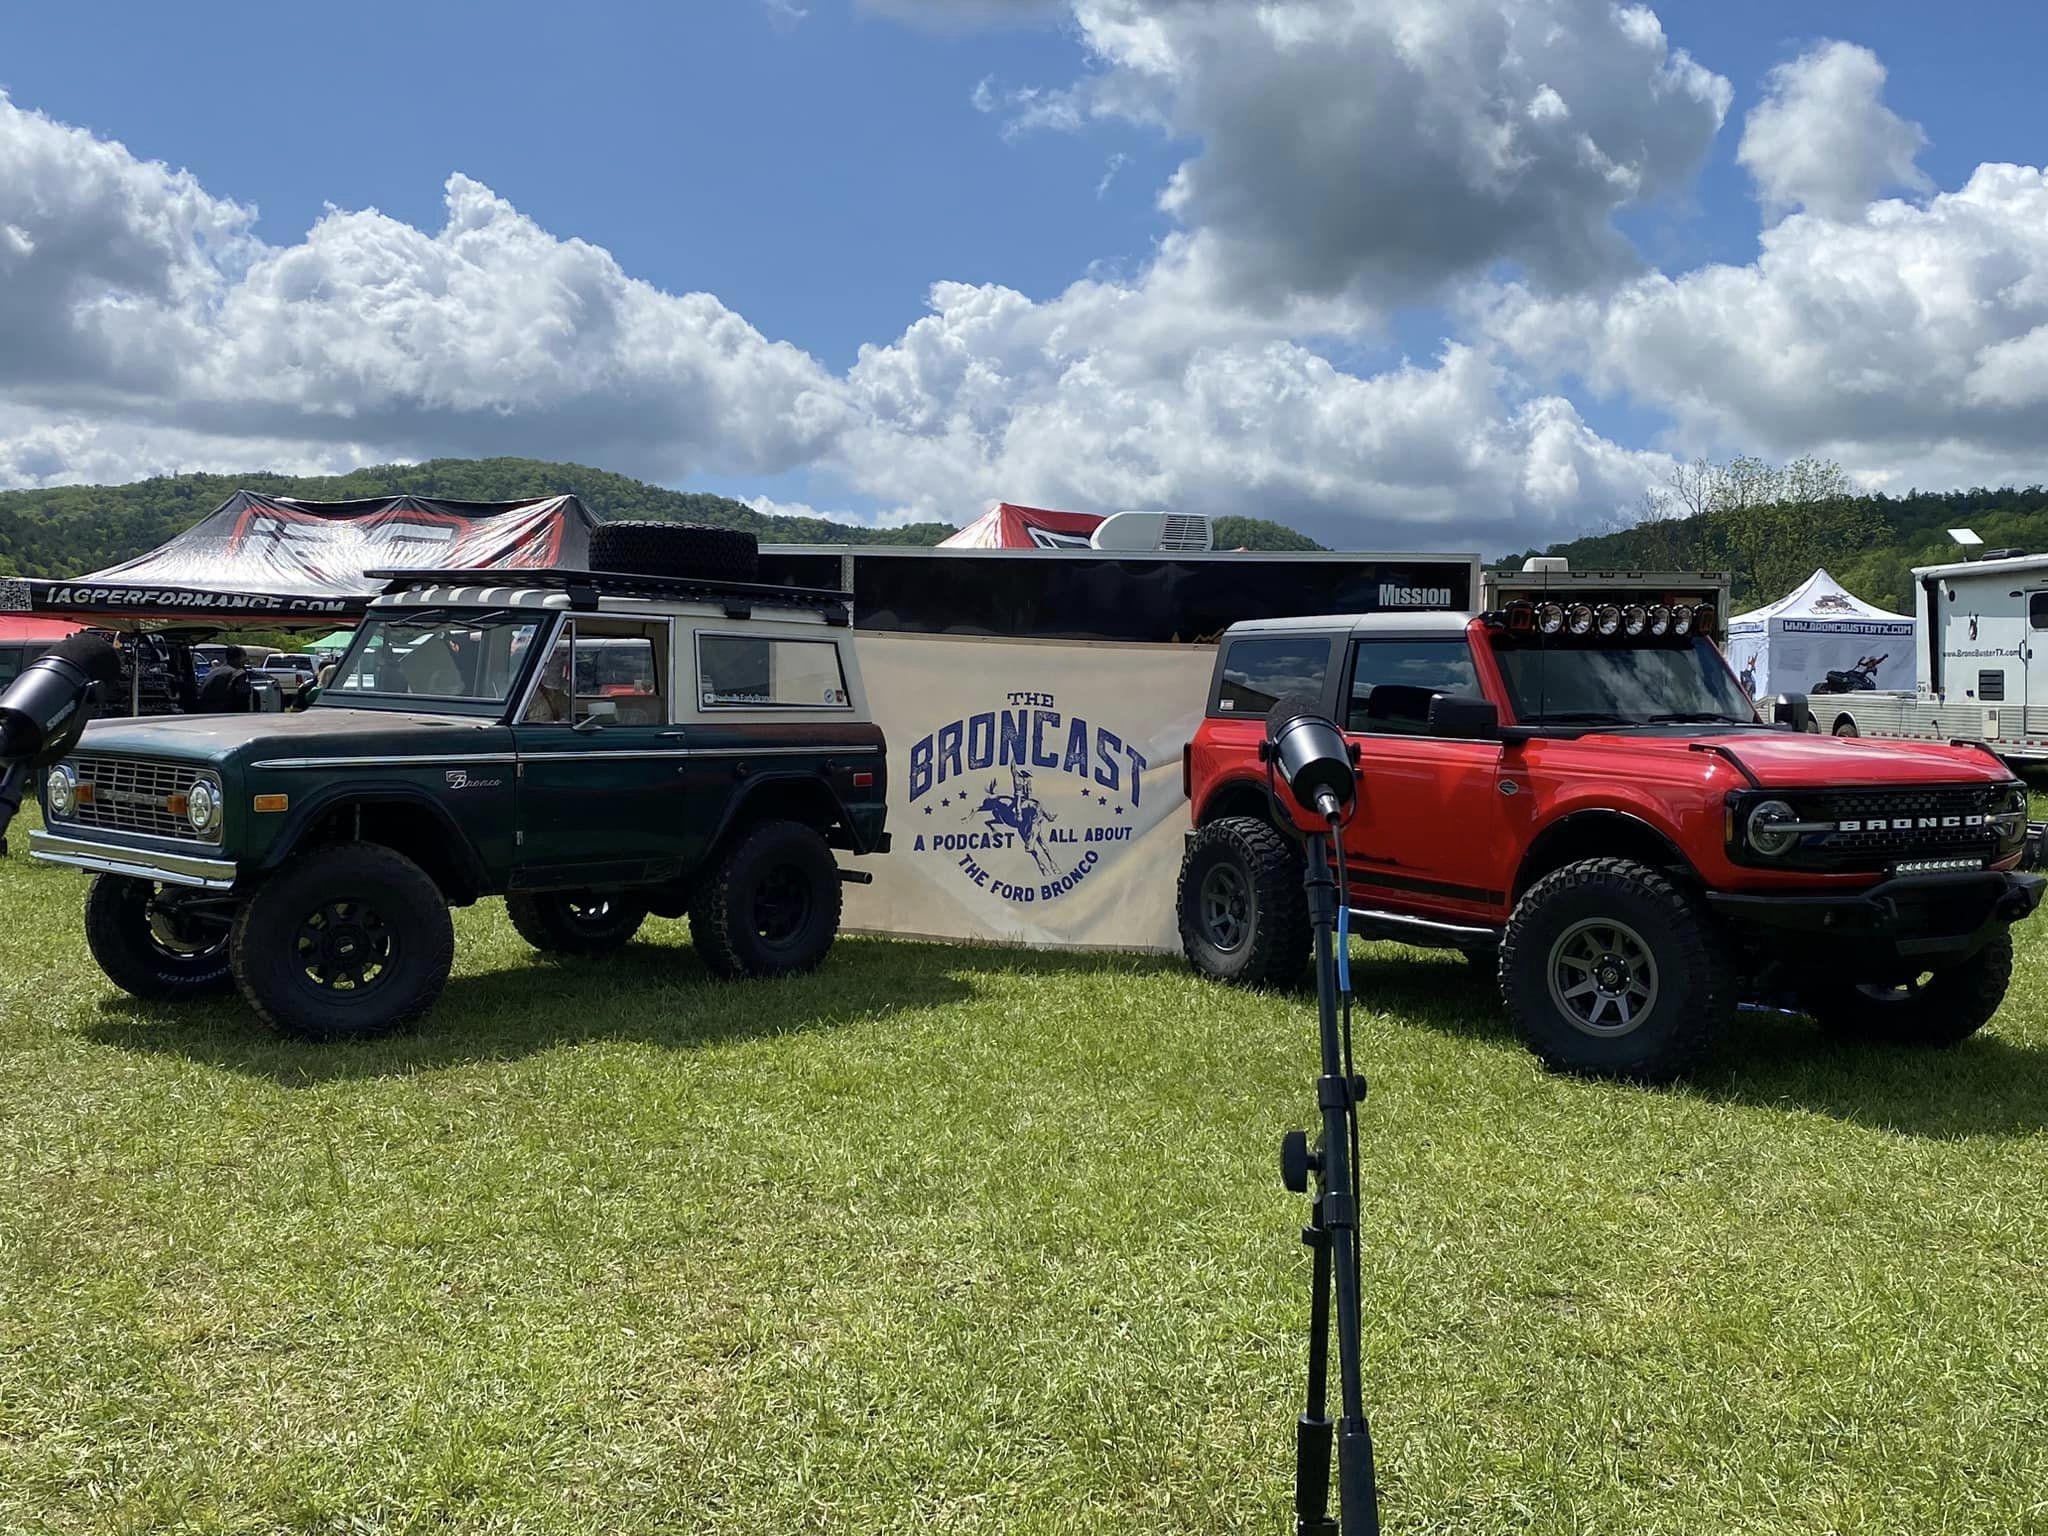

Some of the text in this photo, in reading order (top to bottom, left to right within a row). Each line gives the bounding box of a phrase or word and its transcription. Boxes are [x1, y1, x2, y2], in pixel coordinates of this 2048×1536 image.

[46, 586, 346, 611] IAGPERFORMANCECOM
[1379, 584, 1451, 606] Mission
[1784, 621, 1912, 634] WWW.BRONCBUSTERTX.COM
[1007, 692, 1054, 708] THE
[910, 709, 1147, 808] BRONCAST
[449, 773, 502, 789] Bronco
[1839, 815, 1982, 831] BRONCO
[913, 827, 1132, 851] A PODCAST ALL ABOUT
[958, 850, 1098, 901] THE FORD BRONCO
